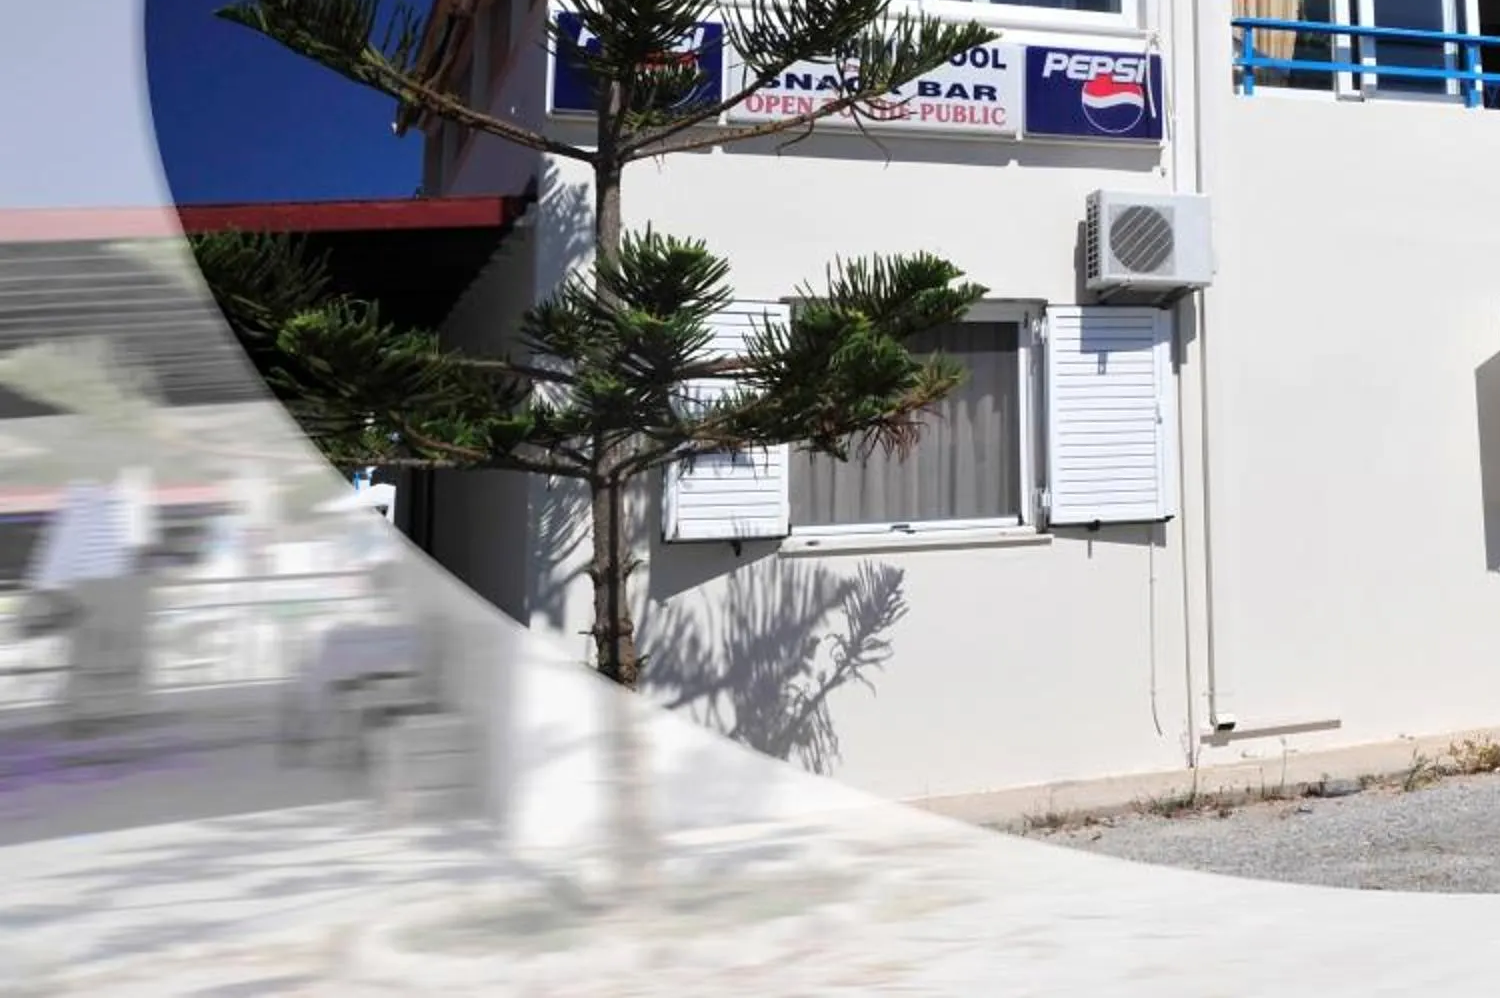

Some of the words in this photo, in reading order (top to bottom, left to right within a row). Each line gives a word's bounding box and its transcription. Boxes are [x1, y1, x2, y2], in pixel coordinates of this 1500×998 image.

[1042, 51, 1146, 84] PEPSI
[917, 80, 998, 102] BAR
[745, 93, 815, 115] OPEN
[919, 103, 1007, 125] PUBLIC
